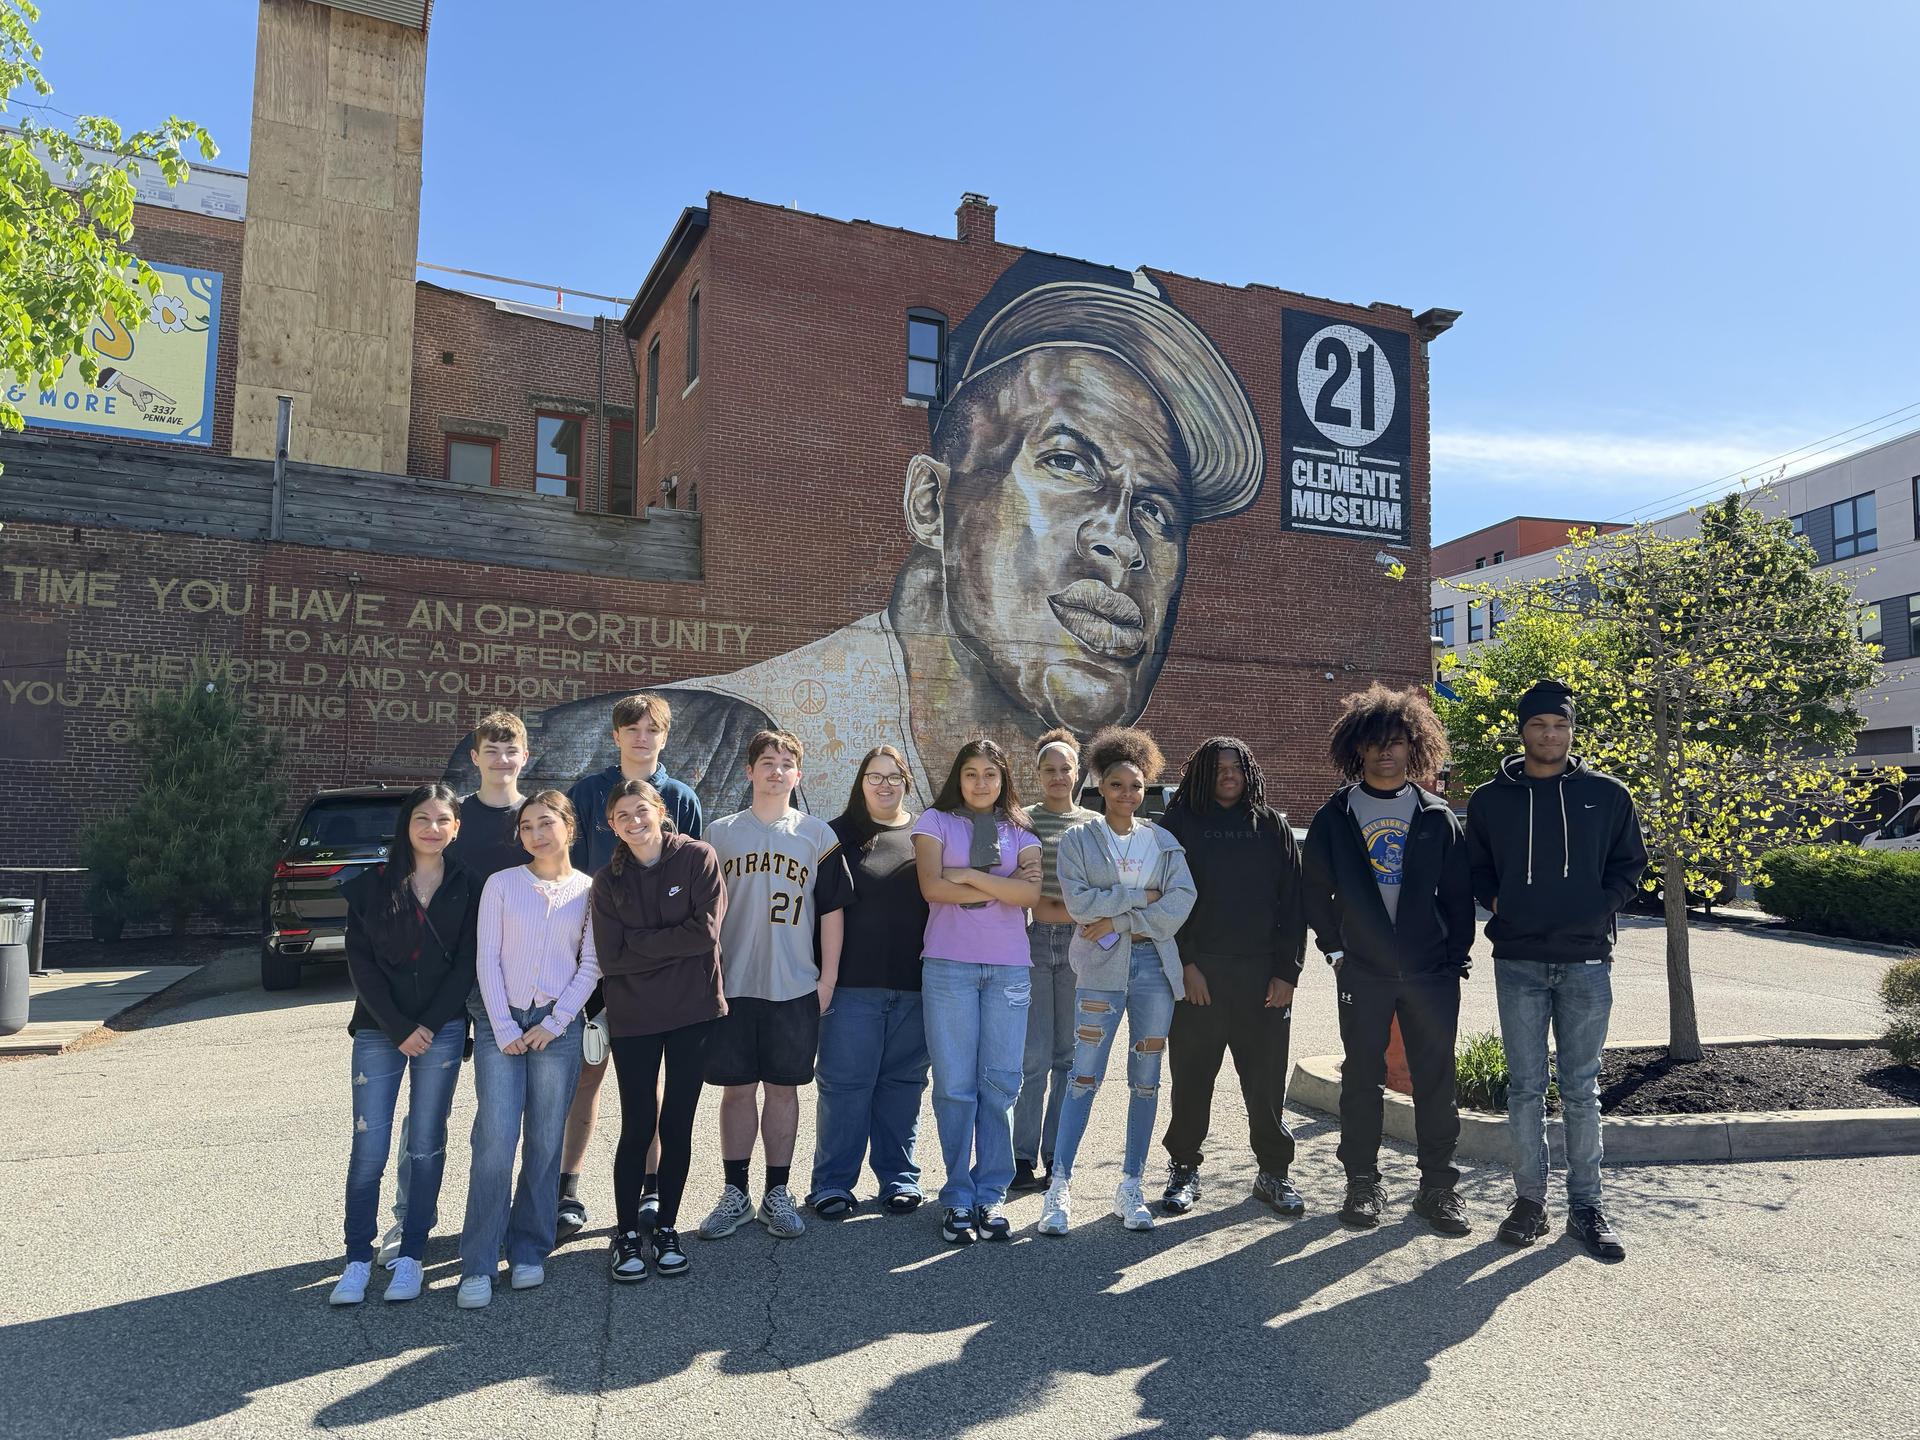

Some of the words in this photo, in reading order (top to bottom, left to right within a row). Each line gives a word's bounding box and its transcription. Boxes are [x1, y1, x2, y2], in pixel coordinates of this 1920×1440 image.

[39, 389, 117, 415] MORE
[1314, 336, 1376, 432] 21
[143, 413, 165, 424] PENN
[166, 415, 184, 426] AVE.
[151, 404, 176, 415] 3337
[1336, 448, 1359, 466] THE
[1291, 458, 1401, 500] CLEMENTE
[1291, 488, 1402, 530] MUSEUM
[3, 565, 121, 608] TIME
[149, 577, 253, 616] YOU
[268, 585, 386, 627] HAVE
[406, 599, 463, 632] AN
[474, 603, 754, 655] OPPORTUNITY
[260, 627, 311, 653] TO
[322, 632, 421, 660] MAKE
[428, 640, 449, 663] A
[458, 640, 671, 677] DIFFERENCE
[65, 649, 100, 674] IN
[106, 651, 186, 680] THE
[190, 656, 328, 687] WORLD
[337, 665, 406, 691] AND
[417, 669, 486, 696] YOU
[494, 674, 586, 701] DON'T
[2, 679, 85, 708] YOU
[365, 698, 457, 724] YOUR
[467, 702, 545, 728] TE
[723, 851, 809, 889] PIRATES
[769, 892, 804, 926] 21
